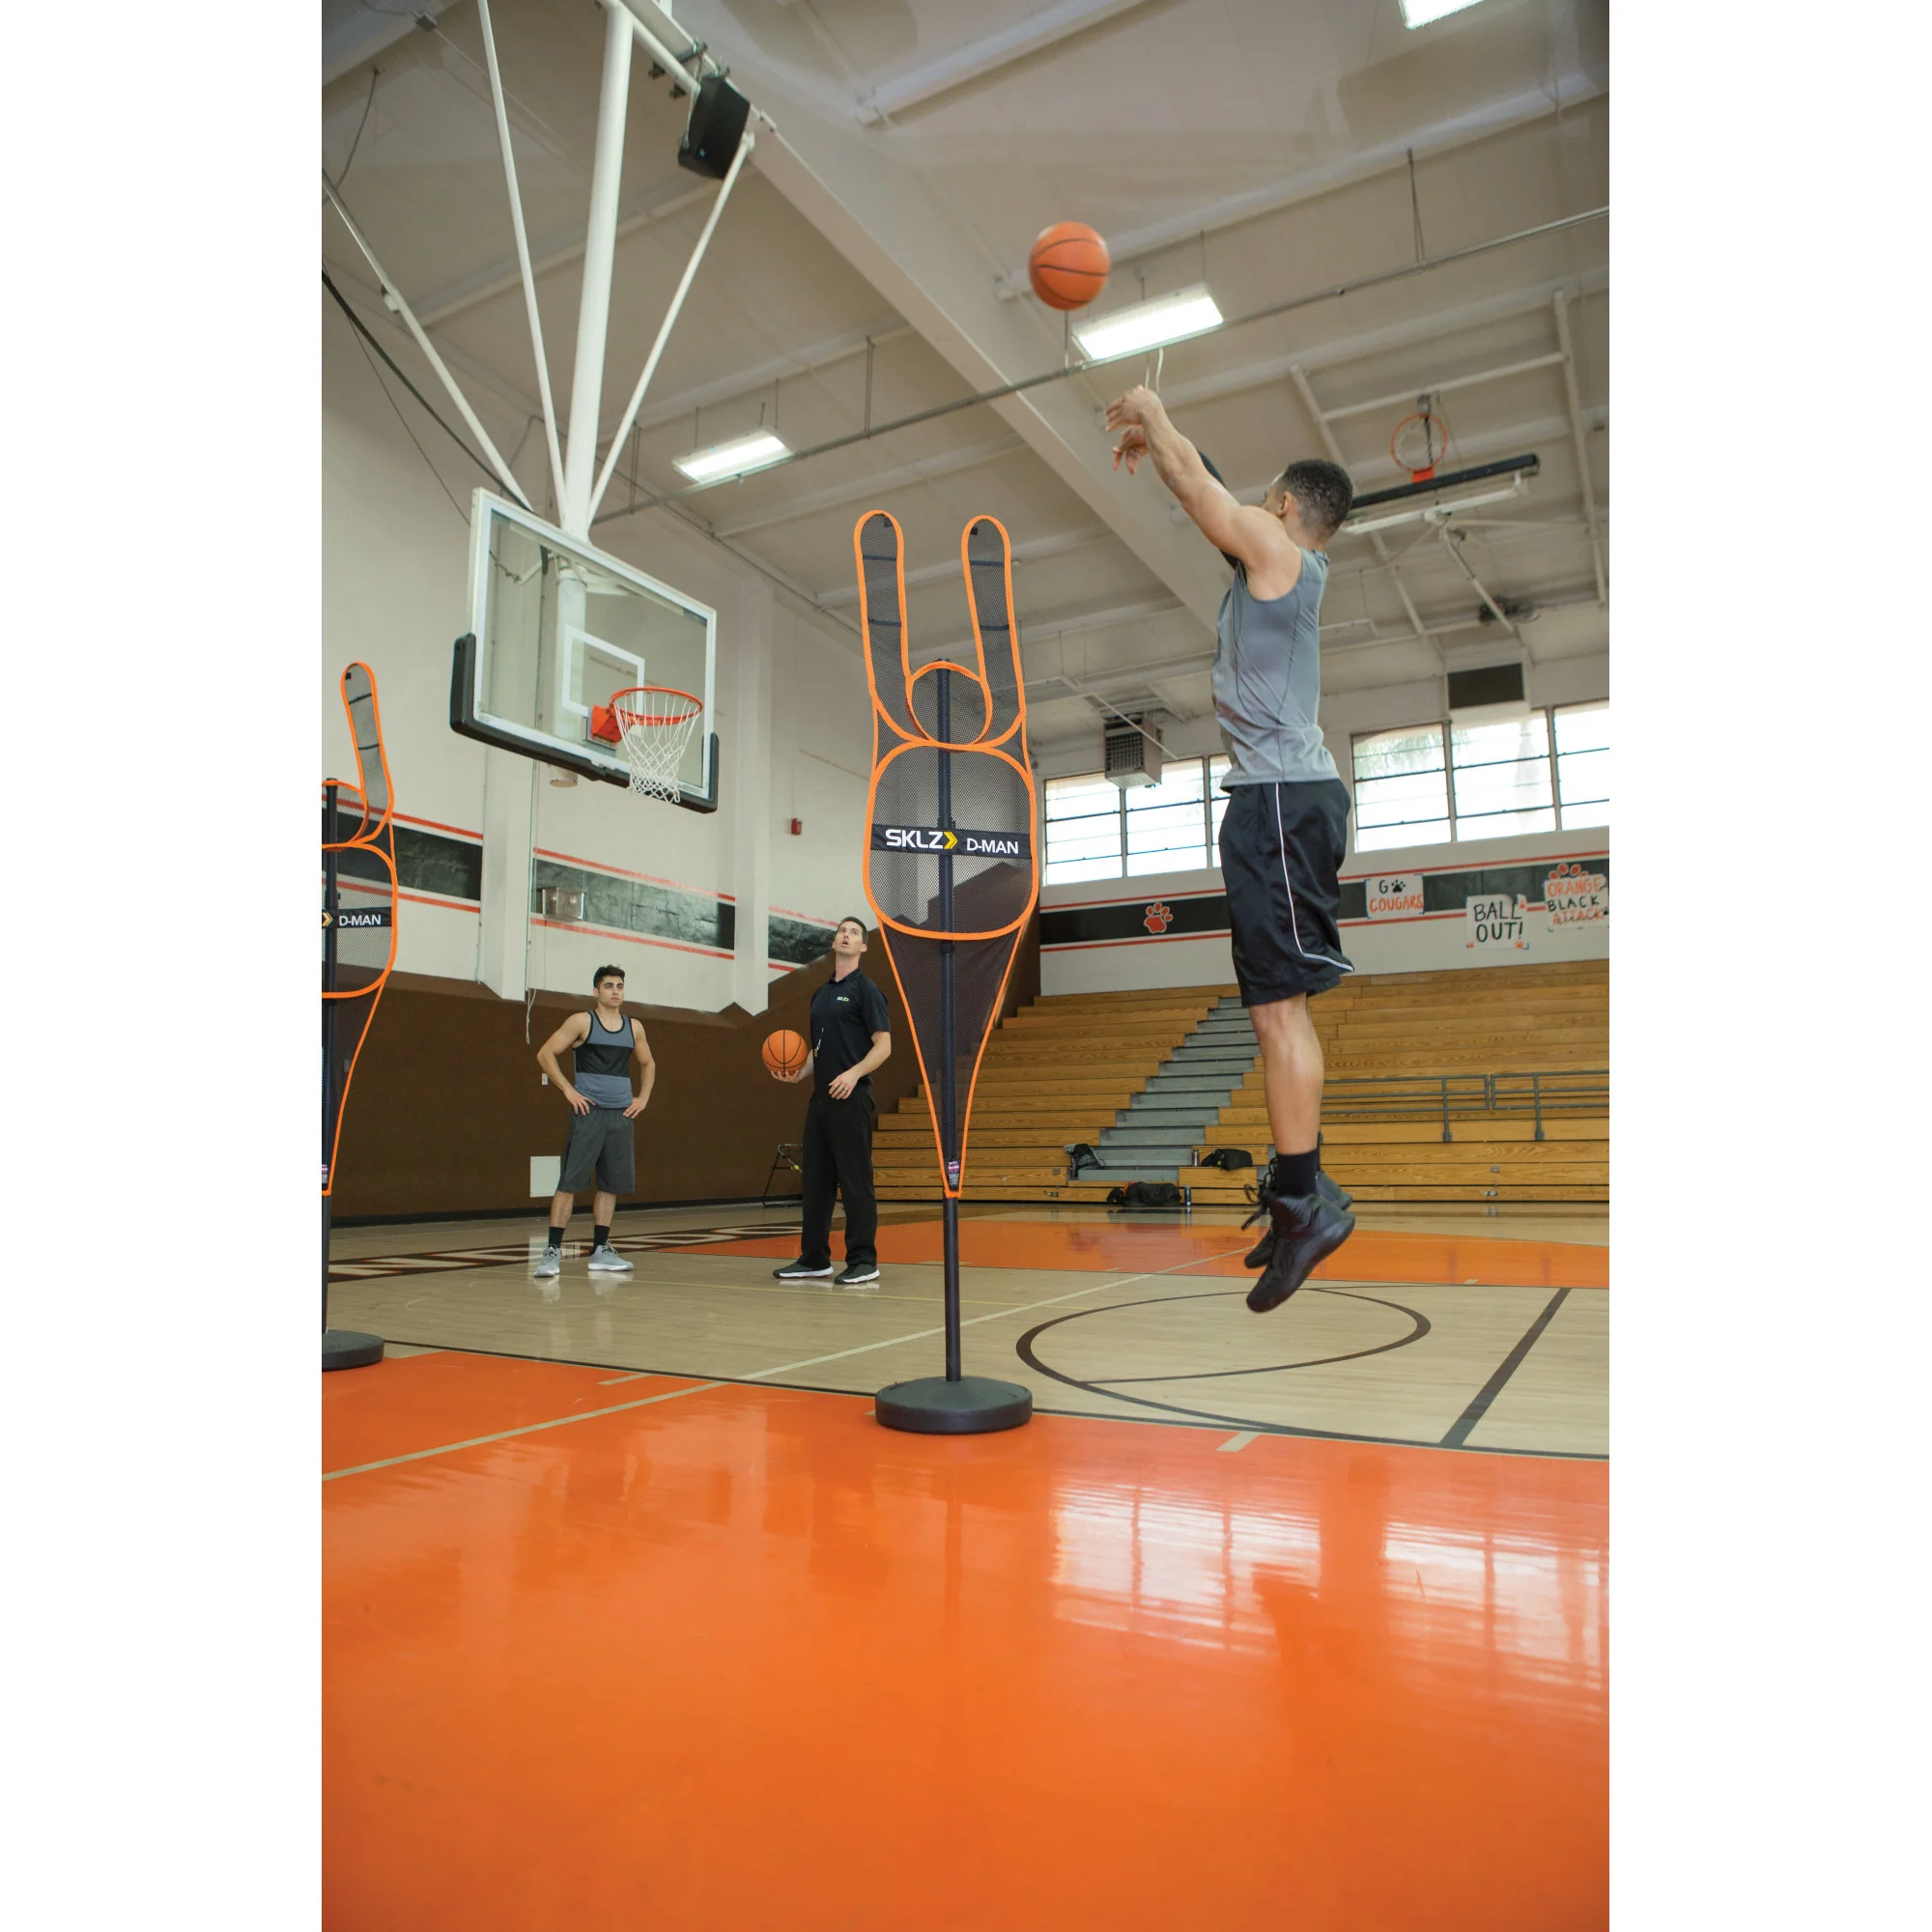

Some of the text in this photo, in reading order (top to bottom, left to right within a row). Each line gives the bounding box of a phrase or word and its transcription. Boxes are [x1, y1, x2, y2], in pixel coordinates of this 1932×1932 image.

[885, 829, 1019, 854] SKLZ D-MAN
[1369, 894, 1424, 913] COUGARS
[1473, 900, 1523, 923] BALL
[1548, 895, 1601, 913] BLACK
[338, 914, 382, 927] D-MAN
[1476, 922, 1524, 943] OUT!
